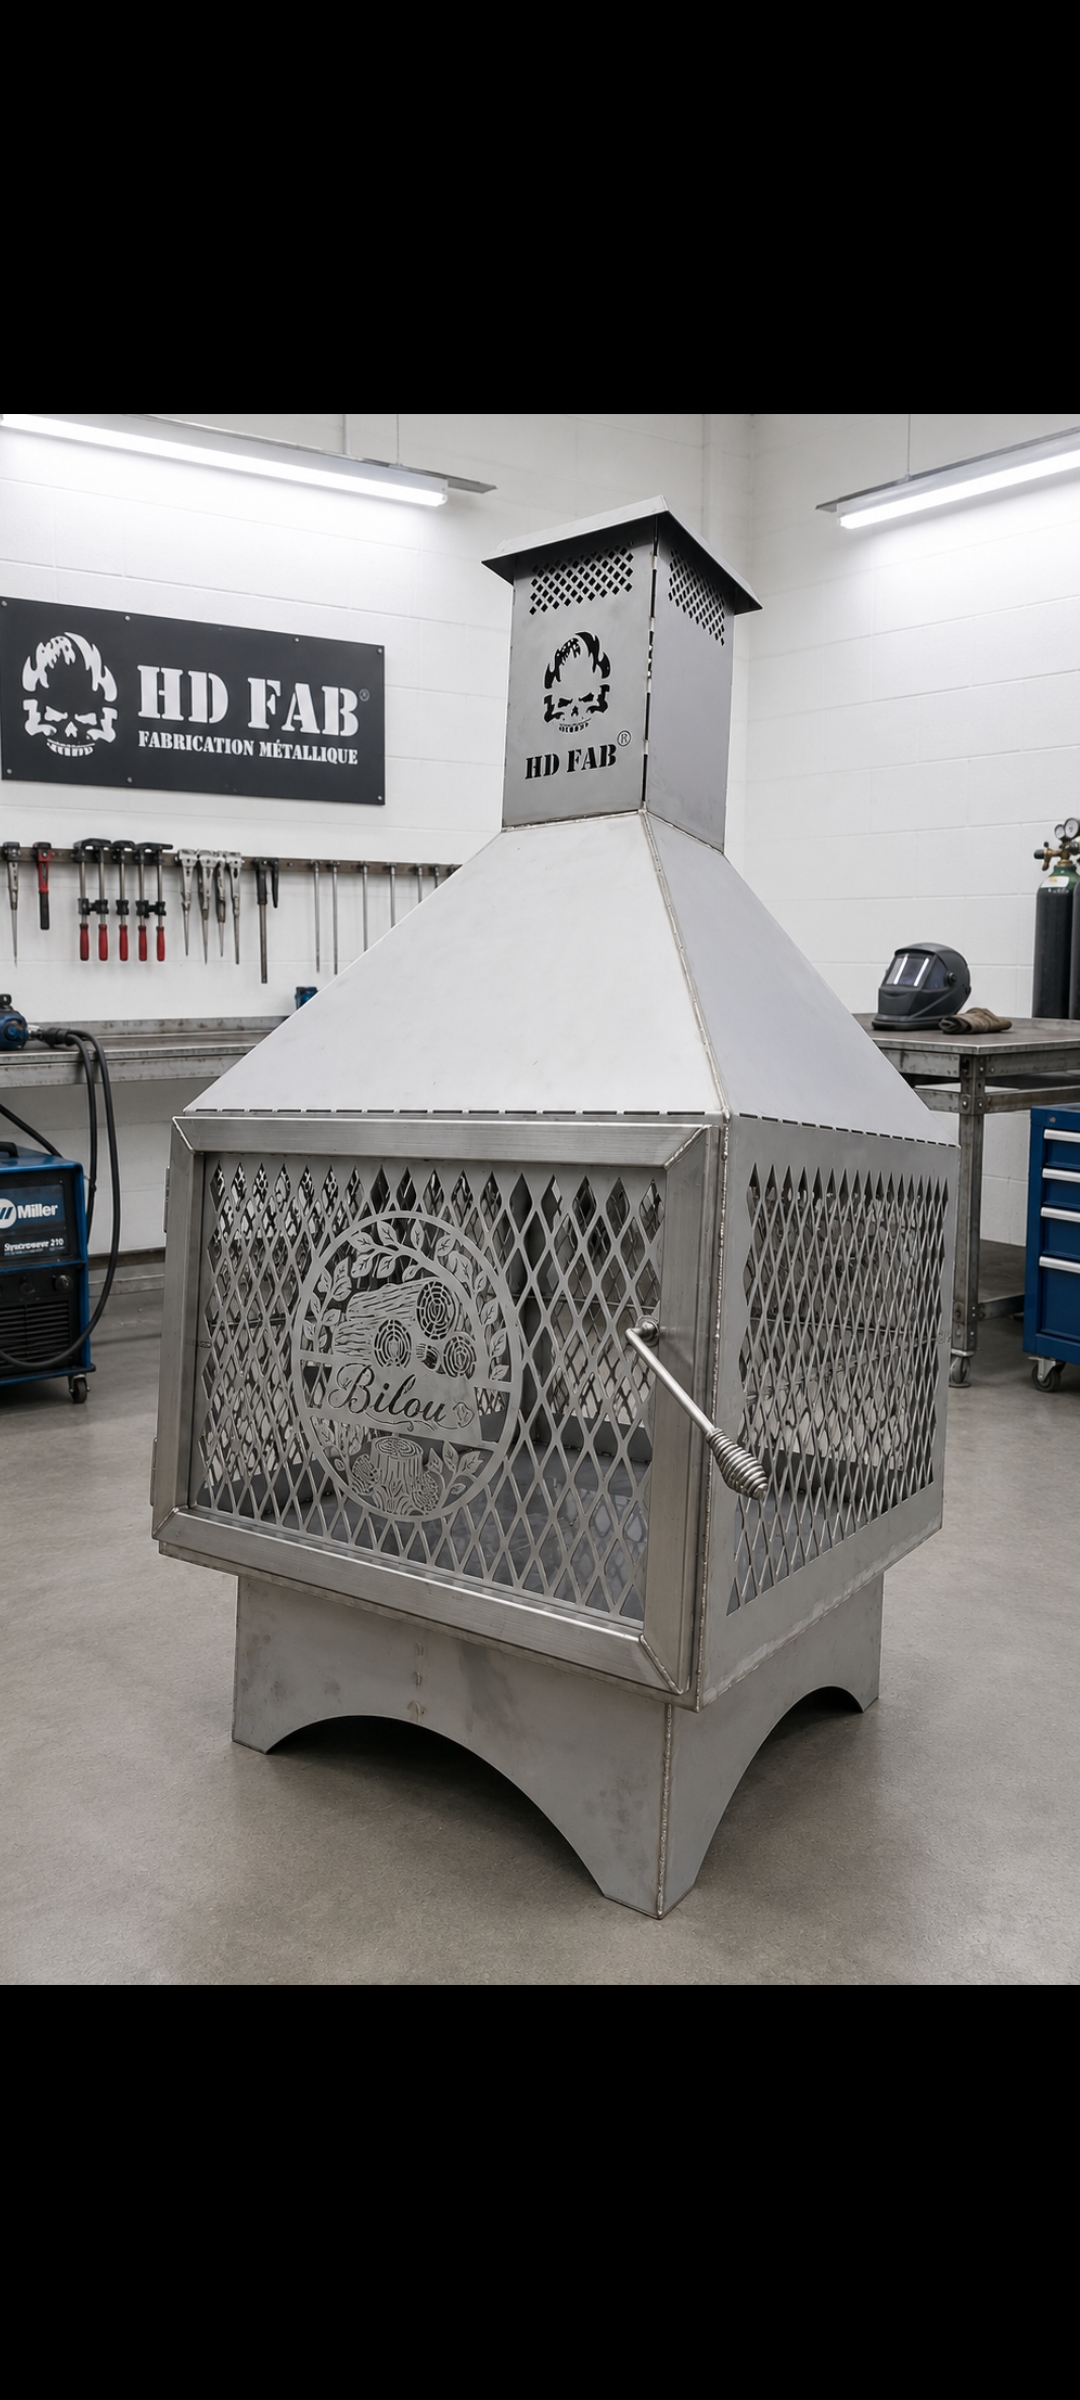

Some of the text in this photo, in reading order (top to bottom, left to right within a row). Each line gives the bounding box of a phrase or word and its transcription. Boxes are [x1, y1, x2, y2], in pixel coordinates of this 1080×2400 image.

[137, 664, 230, 724] HD
[138, 730, 358, 765] FABRICATION MÉTALLIQUE
[524, 753, 560, 780] HD
[17, 1203, 58, 1219] Miller
[328, 1362, 447, 1423] Bilou
